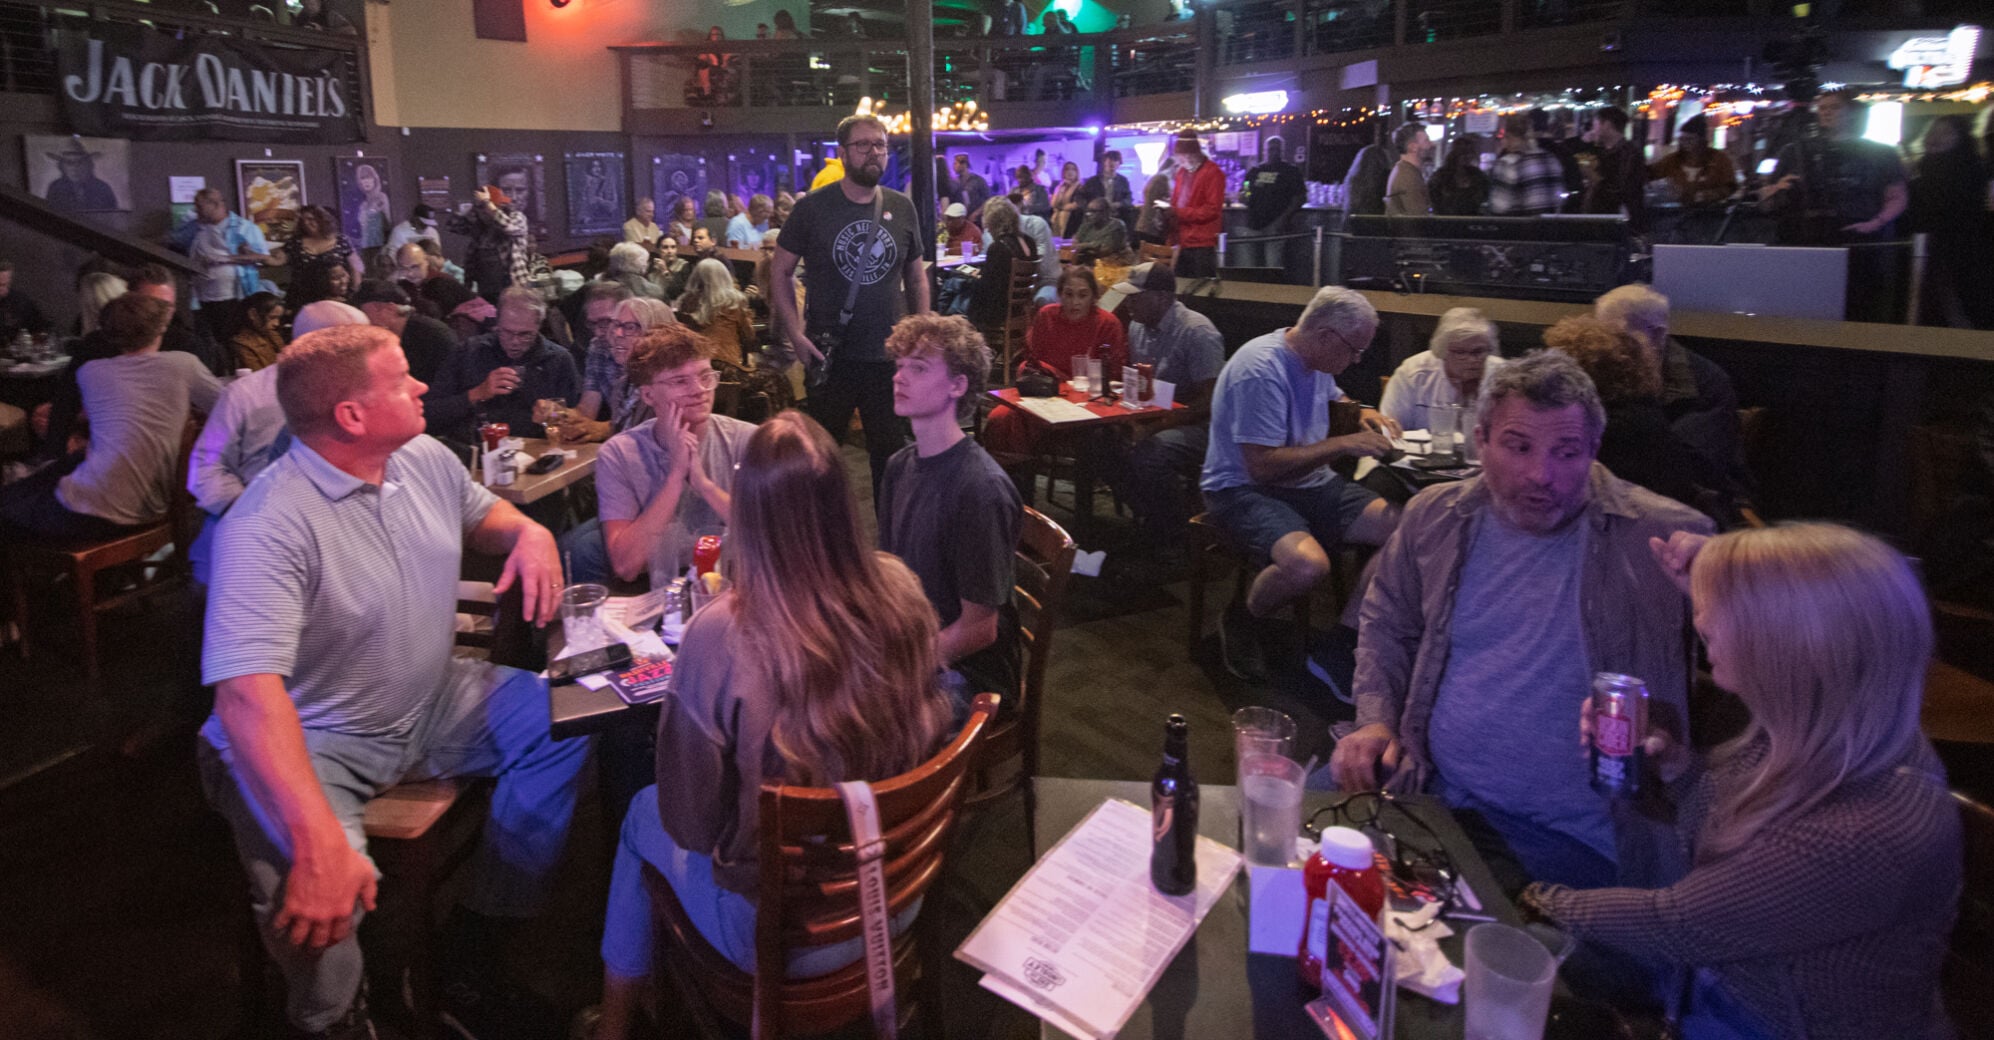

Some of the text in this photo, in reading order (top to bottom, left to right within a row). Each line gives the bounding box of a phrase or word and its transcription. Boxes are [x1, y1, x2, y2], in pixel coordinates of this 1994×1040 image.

[64, 39, 189, 109] JACK
[836, 222, 893, 251] MUSIC NEIBORS
[865, 866, 889, 990] LOUIS VUITTON
